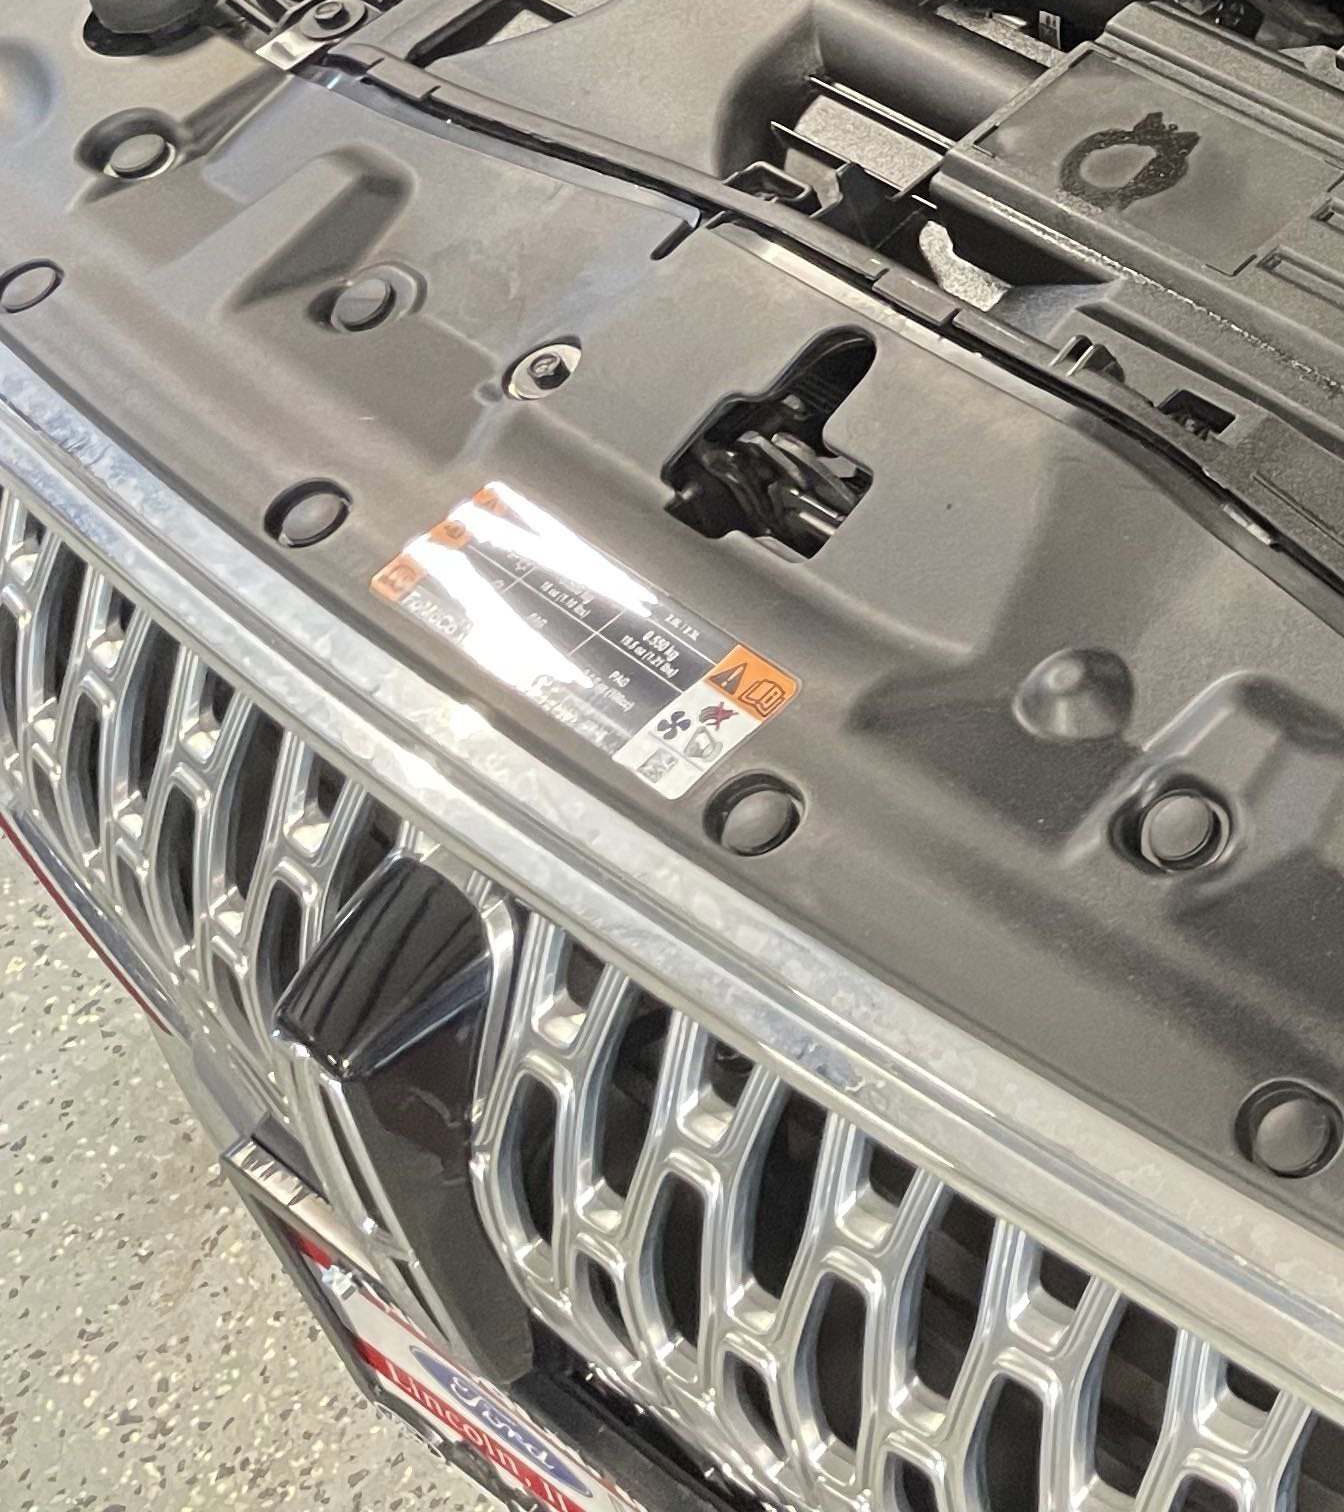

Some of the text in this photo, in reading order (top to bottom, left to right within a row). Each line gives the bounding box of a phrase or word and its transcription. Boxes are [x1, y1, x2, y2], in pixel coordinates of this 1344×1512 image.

[642, 630, 680, 662] 0.550 kg
[451, 1376, 555, 1469] Ford
